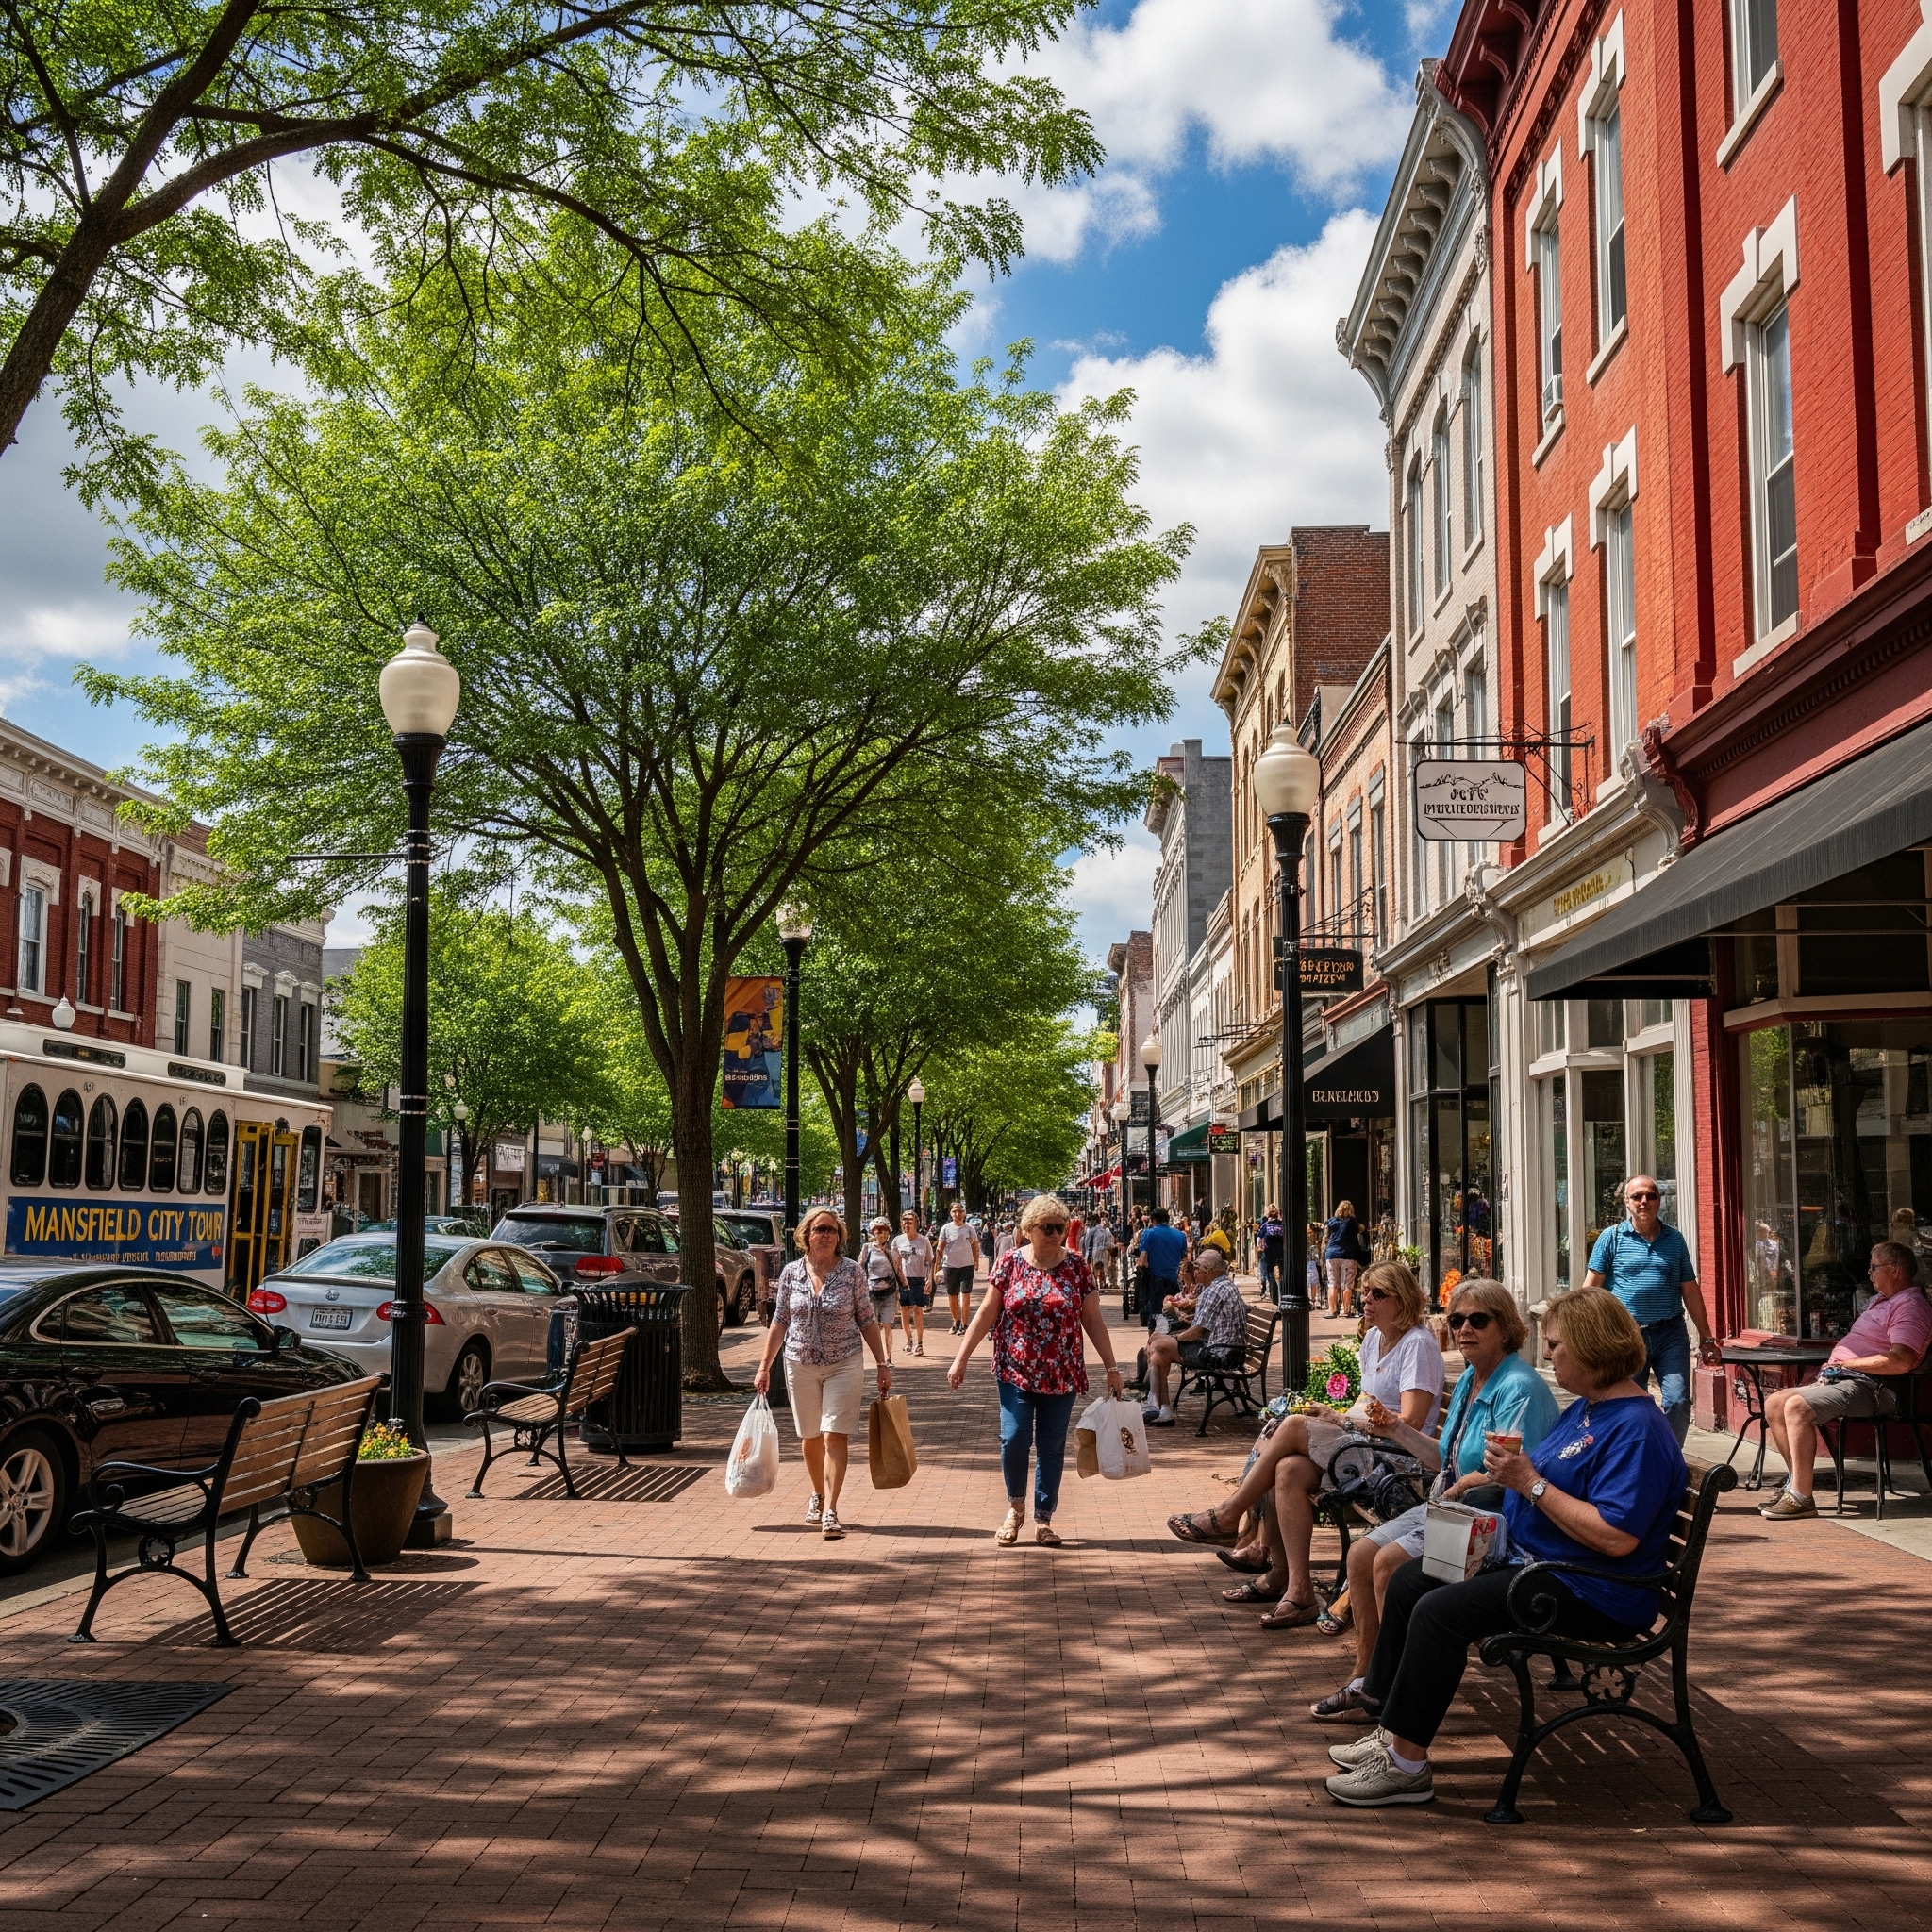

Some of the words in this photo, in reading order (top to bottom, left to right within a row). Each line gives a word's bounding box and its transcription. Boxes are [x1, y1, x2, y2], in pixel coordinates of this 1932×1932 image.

[25, 1205, 141, 1241] MANSFIELD
[147, 1209, 184, 1241] CITY
[189, 1210, 224, 1241] TOUR
